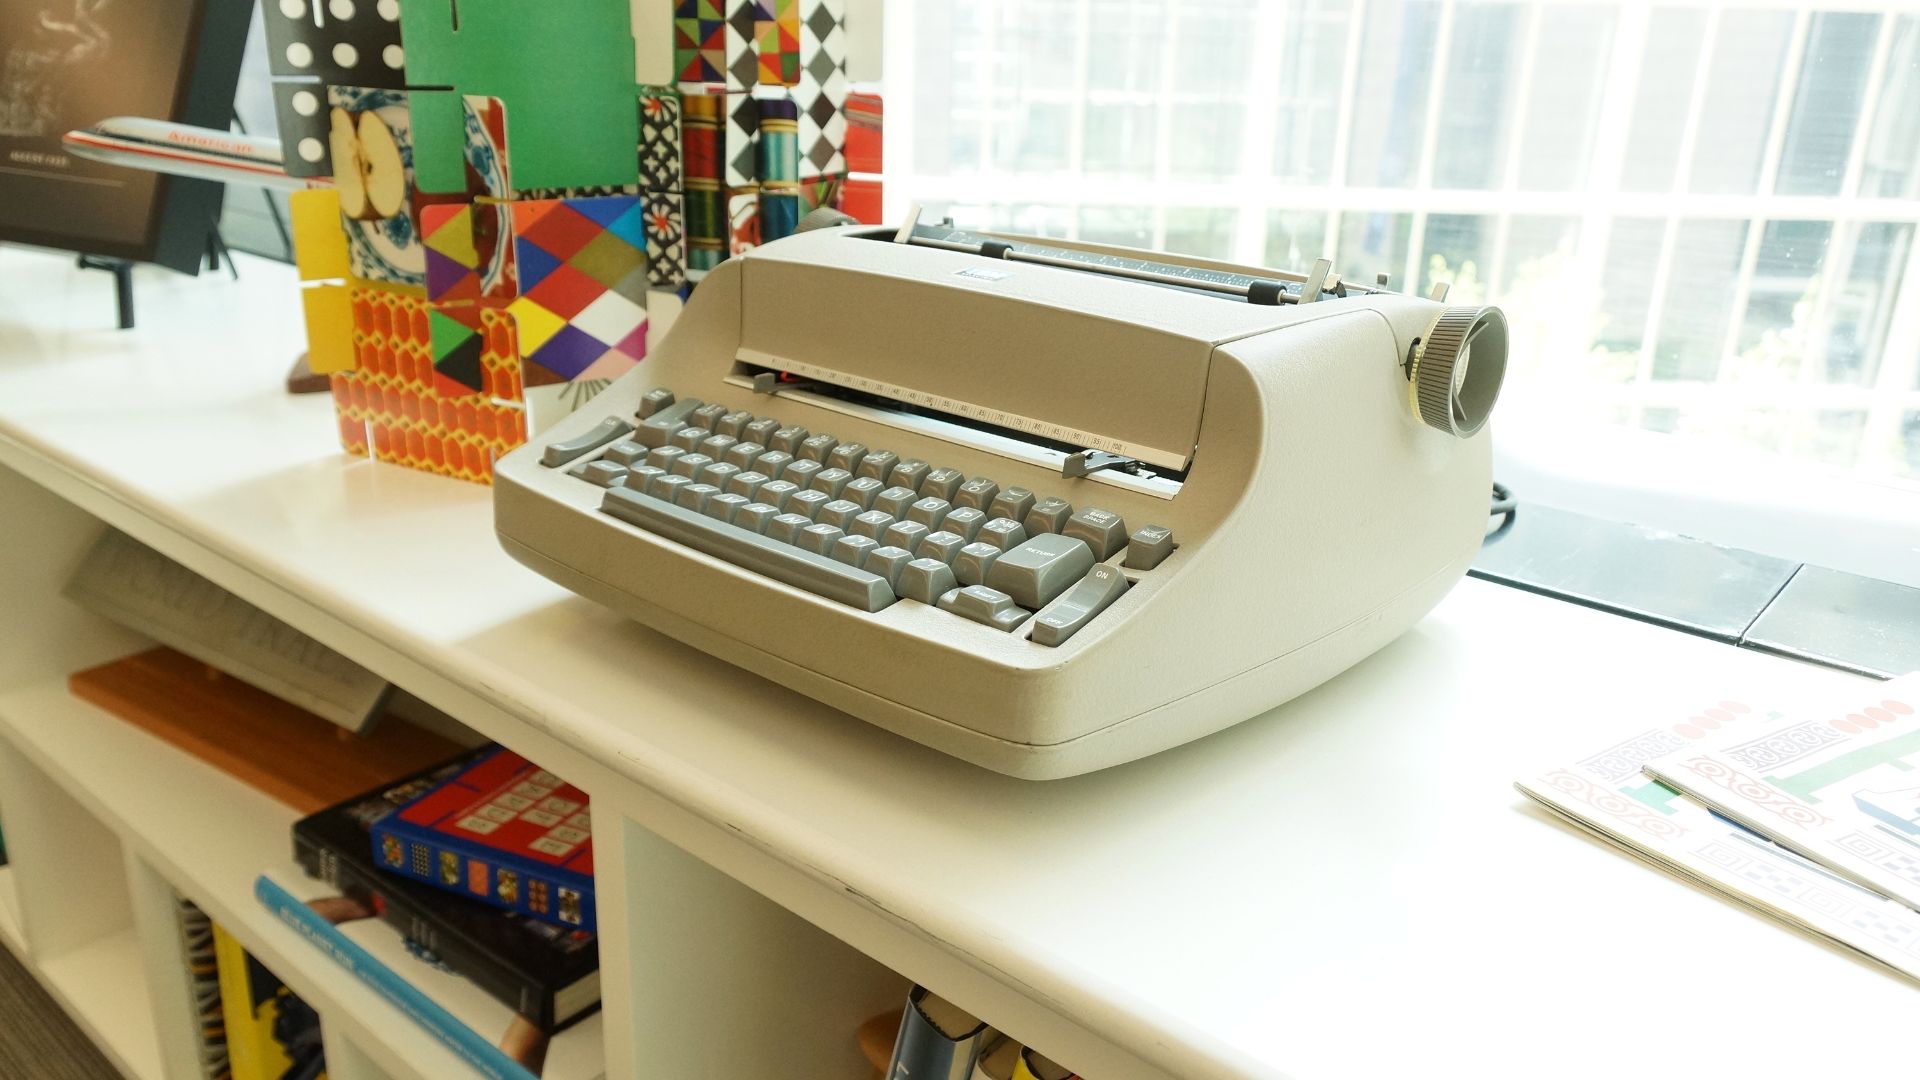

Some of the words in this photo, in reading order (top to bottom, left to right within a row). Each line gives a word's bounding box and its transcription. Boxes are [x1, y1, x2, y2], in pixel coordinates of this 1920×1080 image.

[1083, 515, 1107, 524] SPACE
[1089, 511, 1110, 520] BACK
[1025, 547, 1056, 557] RETURN
[1096, 570, 1110, 579] ON
